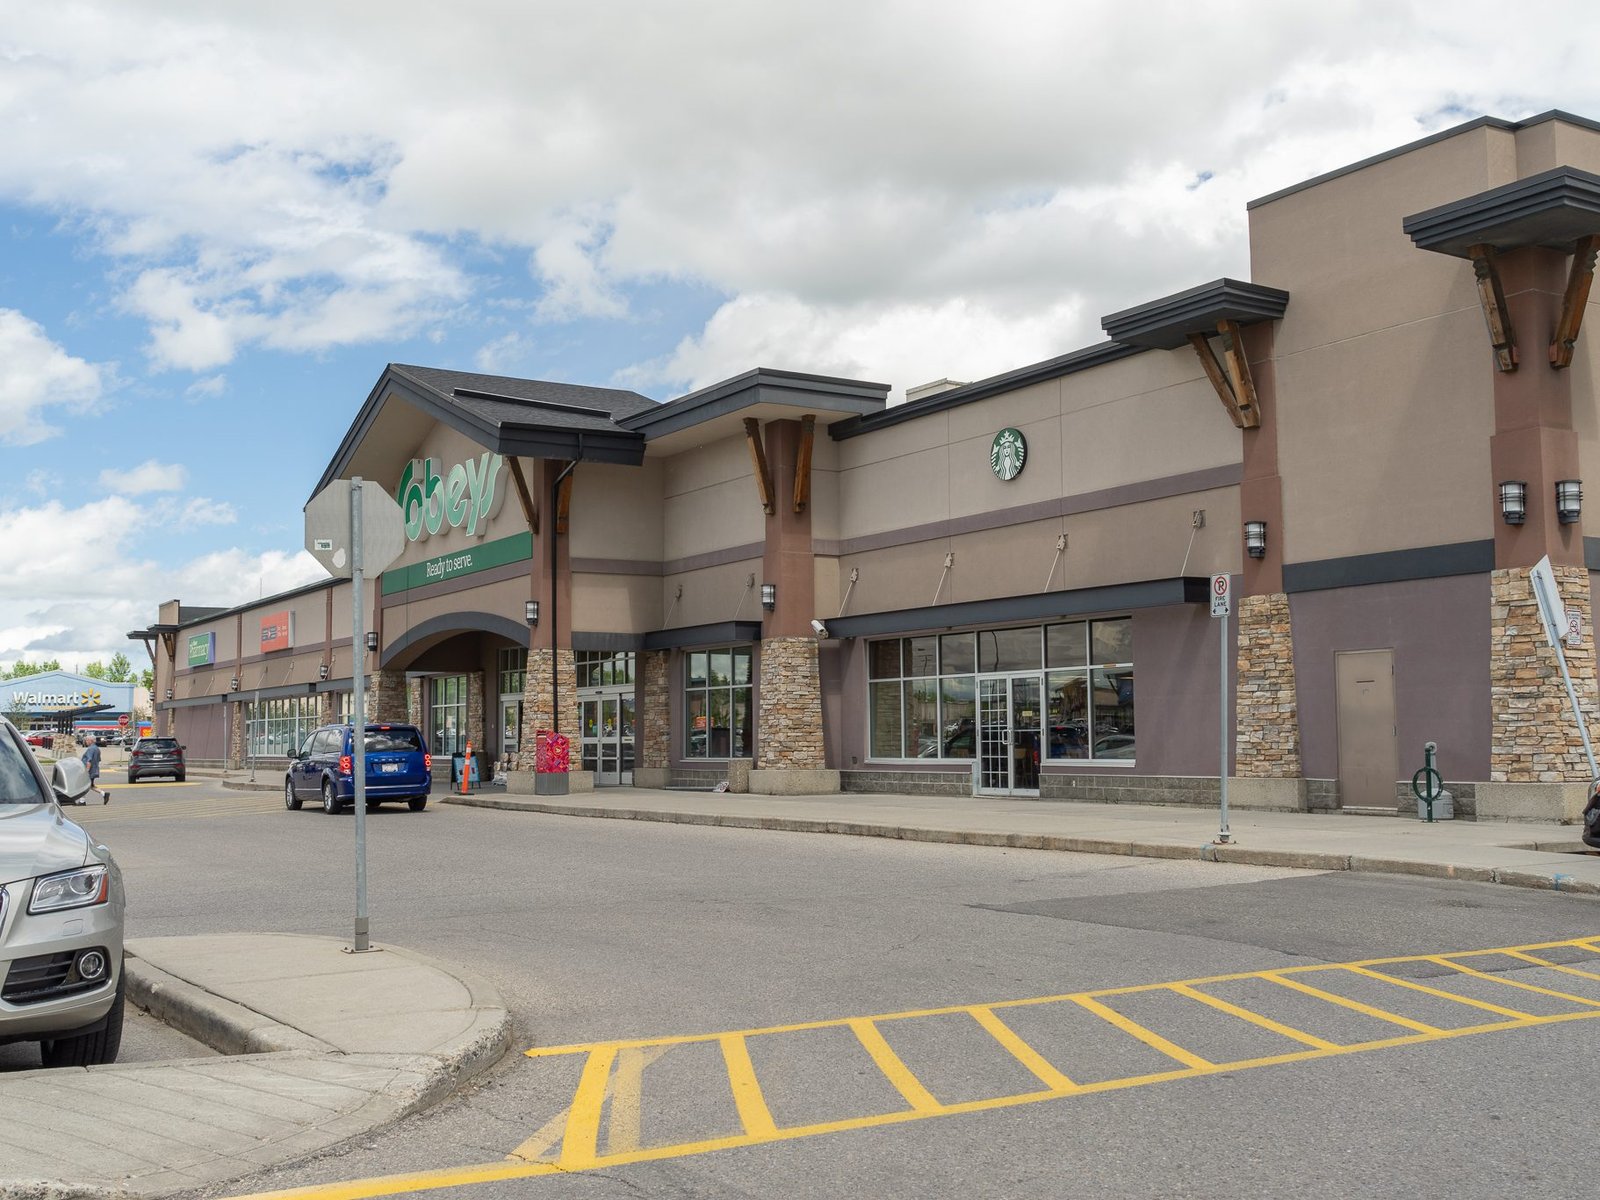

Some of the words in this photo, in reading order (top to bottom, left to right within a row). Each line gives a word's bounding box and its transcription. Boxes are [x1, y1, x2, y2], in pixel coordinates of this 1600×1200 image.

[426, 557, 445, 579] Ready
[446, 558, 453, 572] to
[13, 691, 79, 705] Walmart
